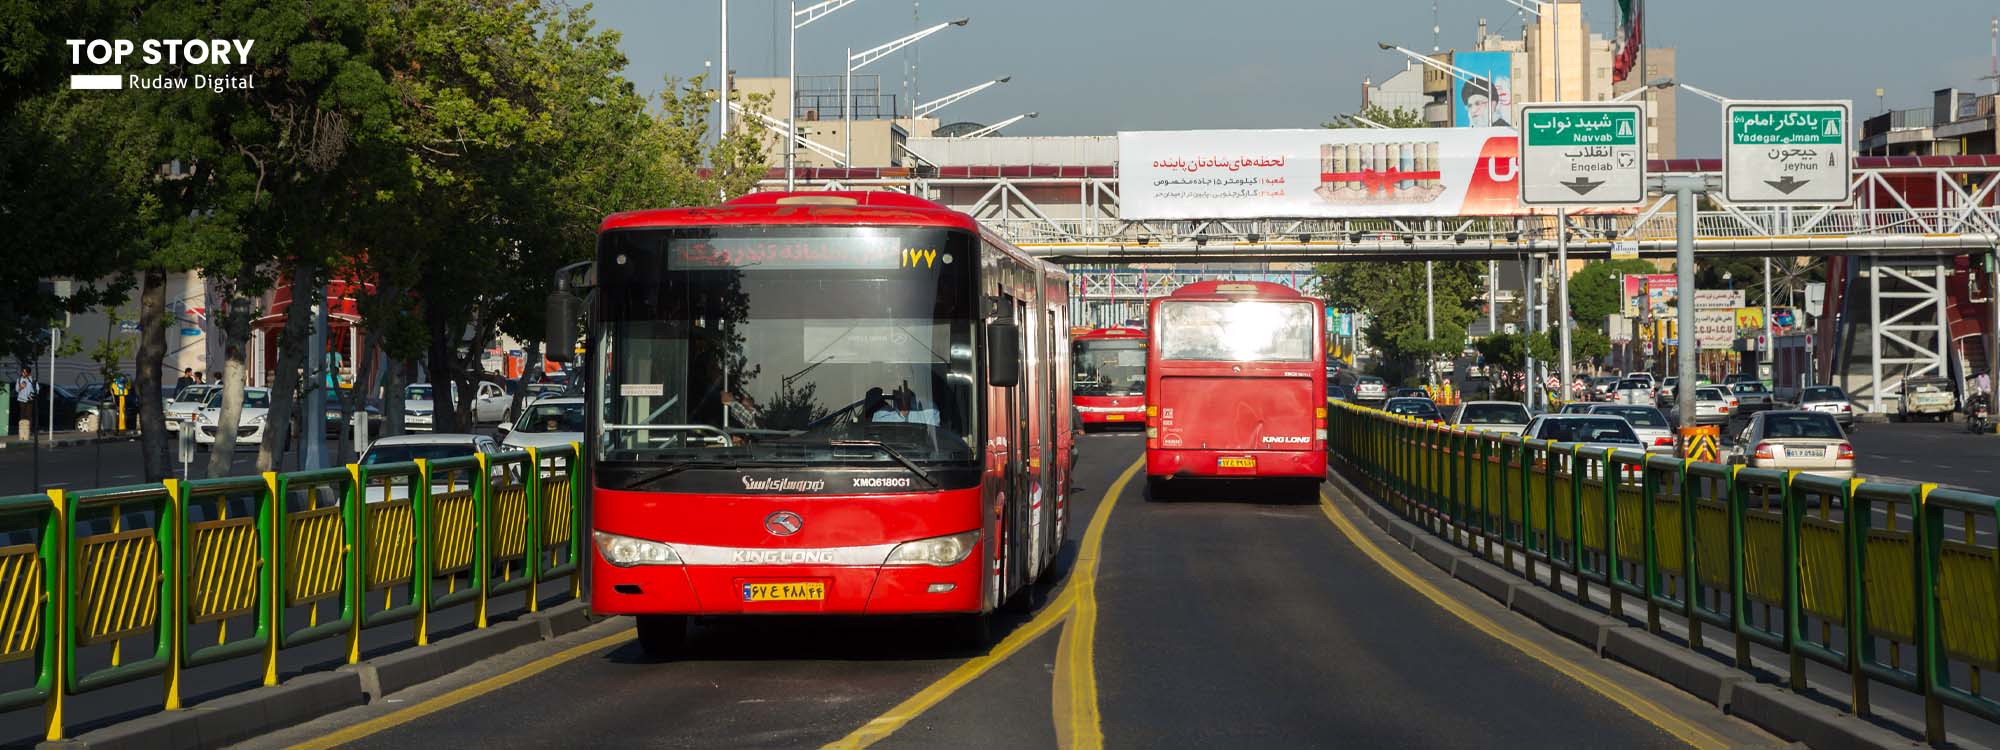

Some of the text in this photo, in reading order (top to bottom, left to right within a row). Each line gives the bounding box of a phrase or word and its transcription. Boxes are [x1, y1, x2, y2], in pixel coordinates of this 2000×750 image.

[1533, 113, 1612, 135] شهید نواب
[1744, 113, 1773, 133] امام
[1775, 112, 1818, 131] یادگار
[1573, 133, 1613, 142] Navvab
[1564, 146, 1613, 161] انقلاب
[1768, 148, 1817, 162] جیحون
[1153, 177, 1193, 187] مخصوص
[1194, 177, 1211, 186] جاده
[1223, 177, 1258, 187] کیلومتر
[902, 247, 937, 269] ۱۷۷
[1262, 436, 1285, 444] KING
[852, 477, 911, 488] XMQ6180G1
[732, 550, 833, 564] KING LONG
[752, 585, 823, 598] ۶۷ ع ۴۸۸ ۴۴
